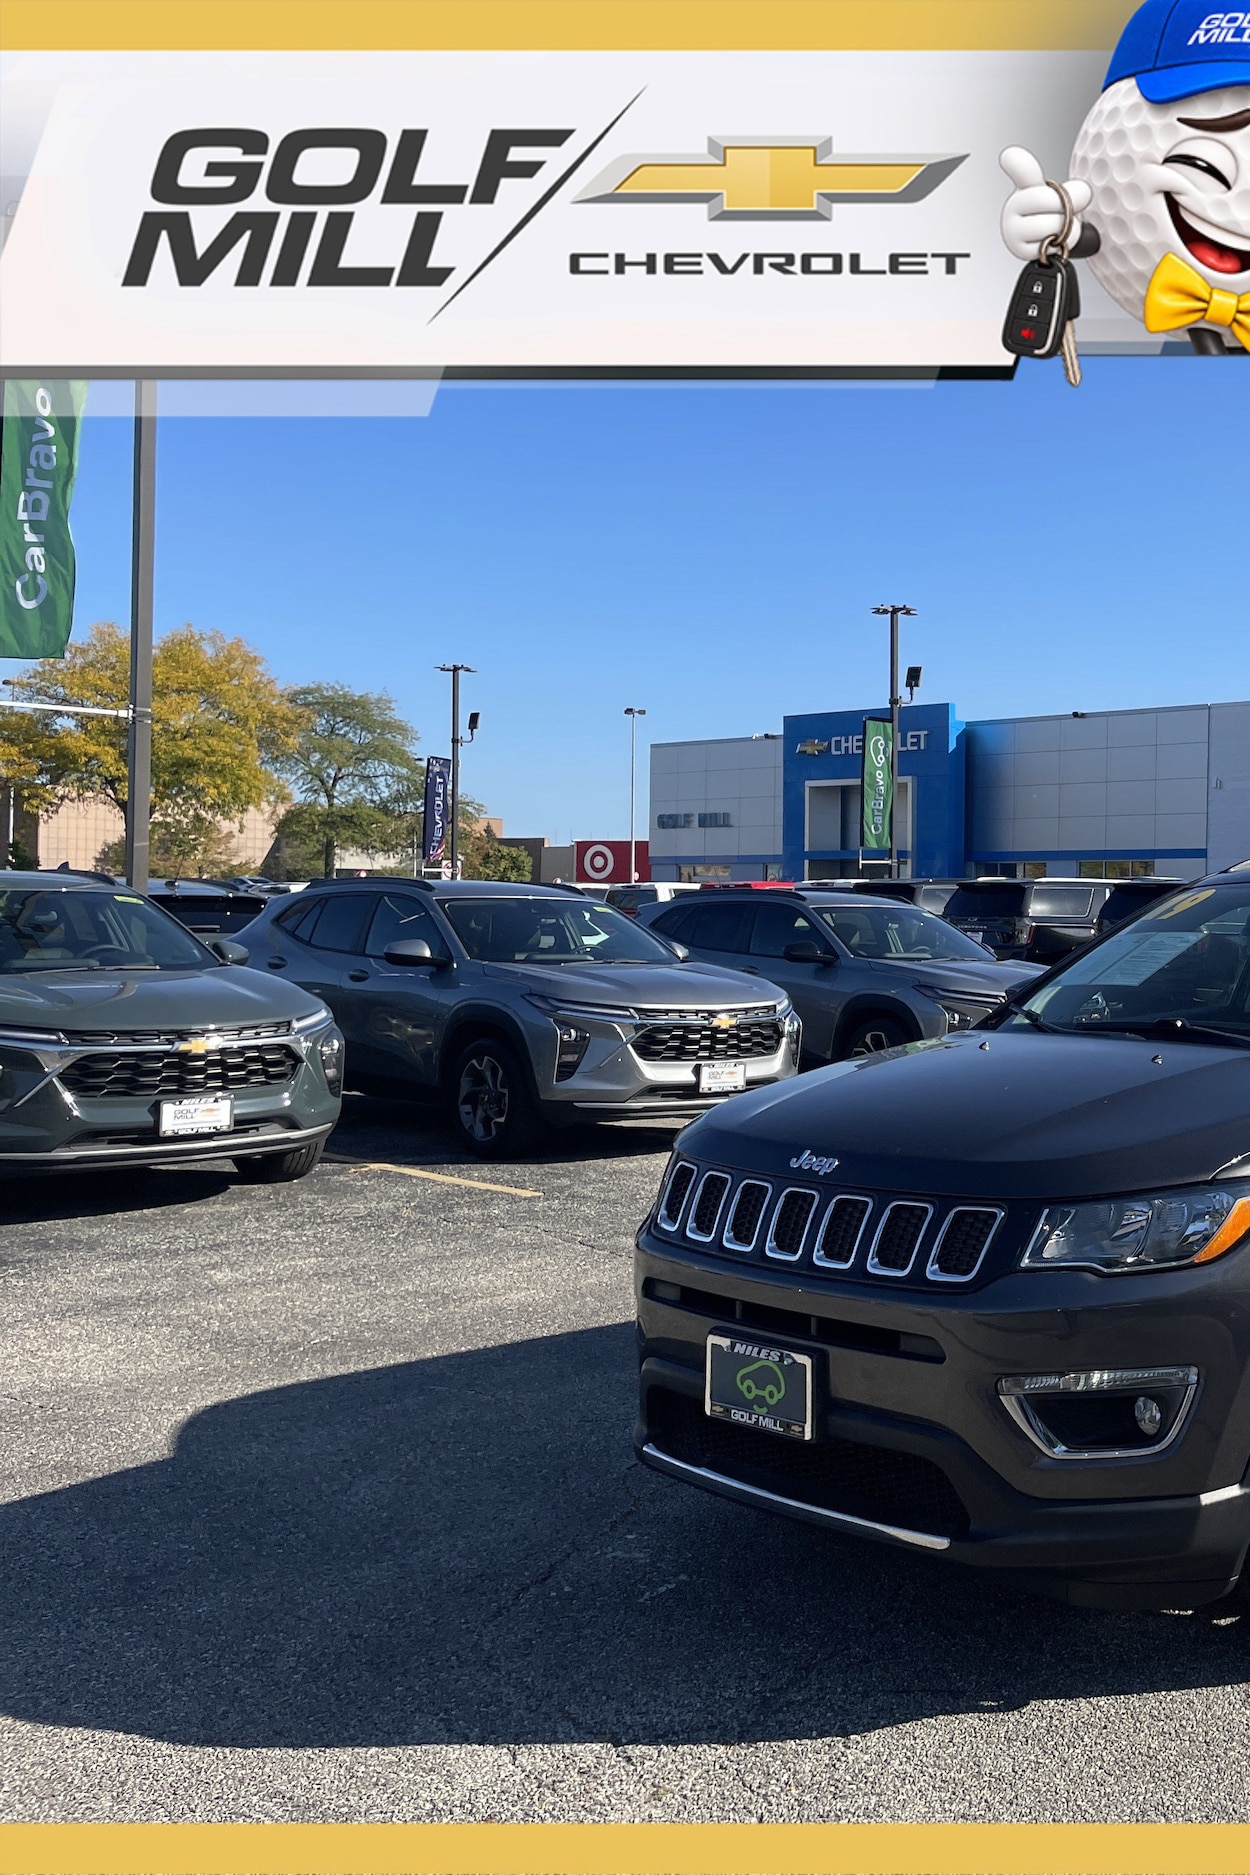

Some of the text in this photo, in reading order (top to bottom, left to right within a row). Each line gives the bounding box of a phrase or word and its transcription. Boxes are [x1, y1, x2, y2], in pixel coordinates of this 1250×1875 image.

[16, 387, 57, 610] CarBravo
[831, 730, 928, 756] CHELET
[429, 775, 444, 855] CHEVROLET
[870, 769, 885, 835] CarBravo
[789, 1149, 839, 1176] Jeep
[733, 1342, 781, 1362] NILES
[731, 1409, 784, 1432] GOLF MILL
